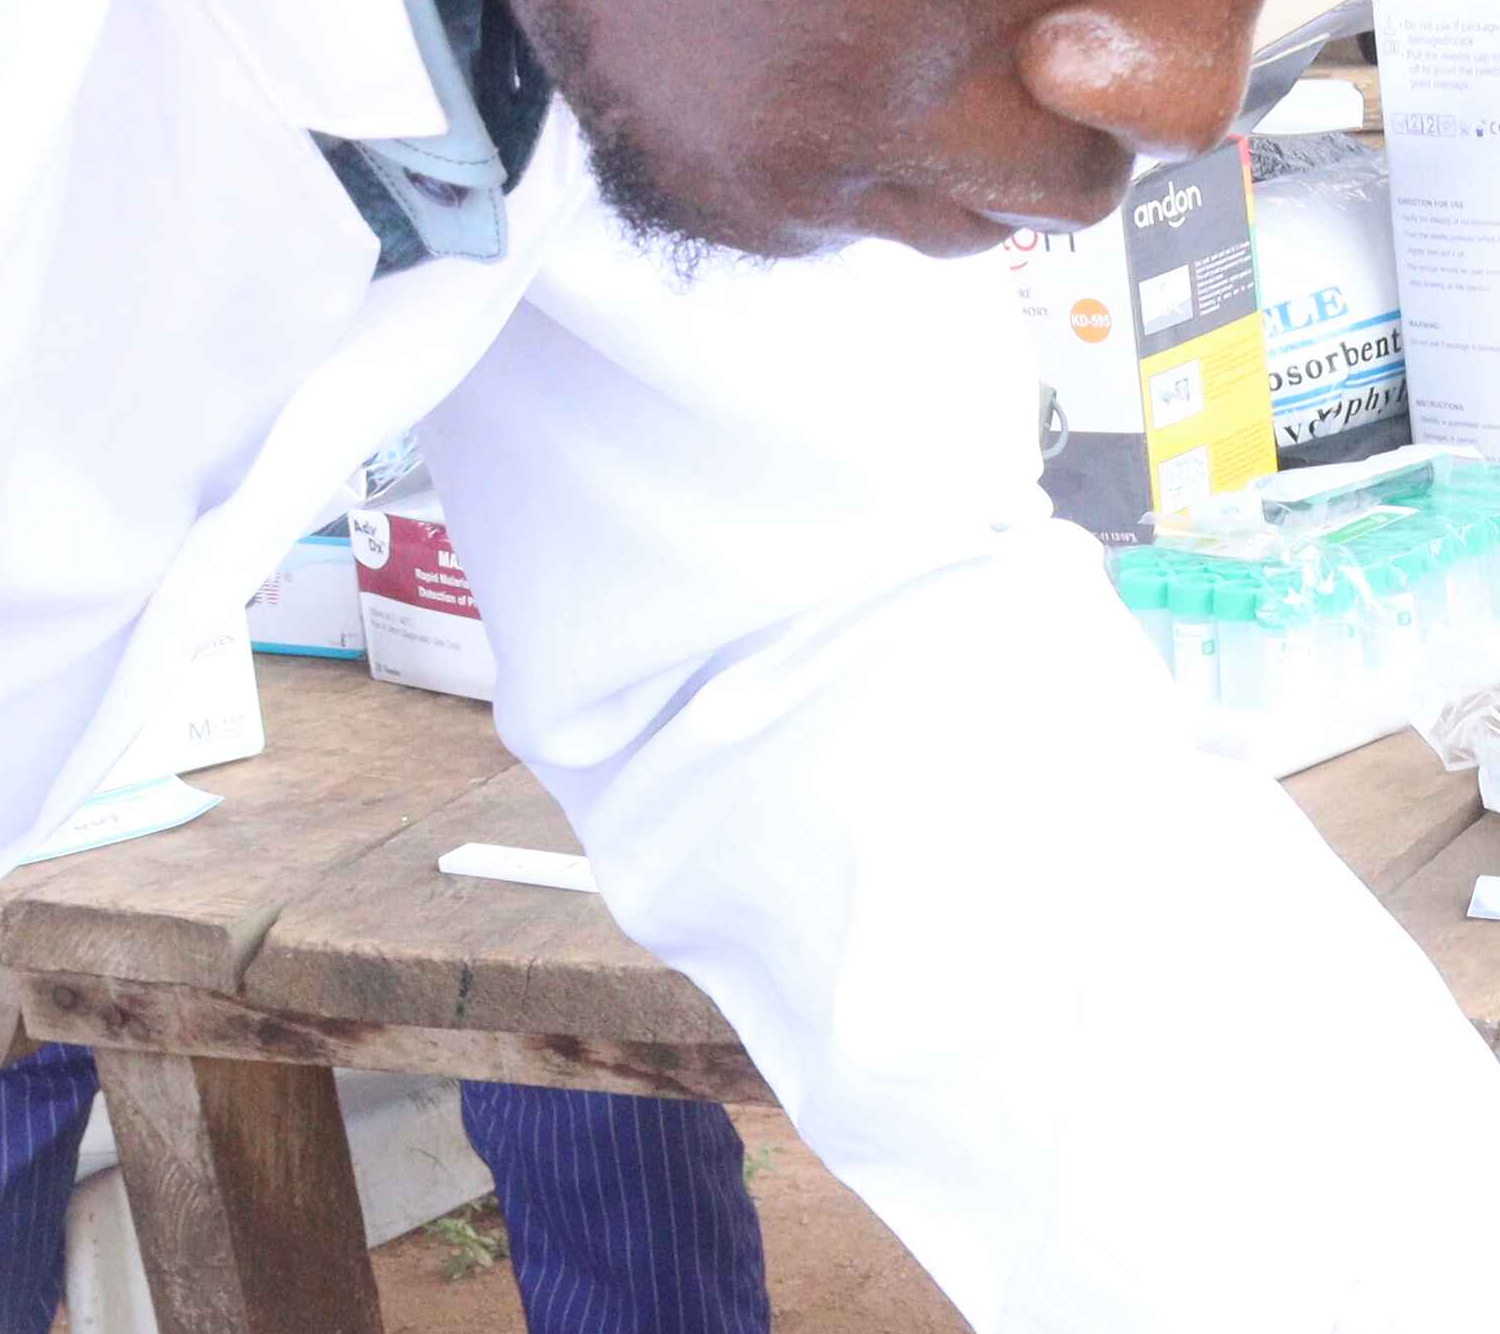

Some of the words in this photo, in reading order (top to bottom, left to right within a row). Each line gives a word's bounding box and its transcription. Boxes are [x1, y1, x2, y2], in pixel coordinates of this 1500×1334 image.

[1133, 180, 1202, 228] andon
[1263, 284, 1349, 338] LE
[354, 520, 377, 536] Adv
[368, 537, 384, 554] Dx
